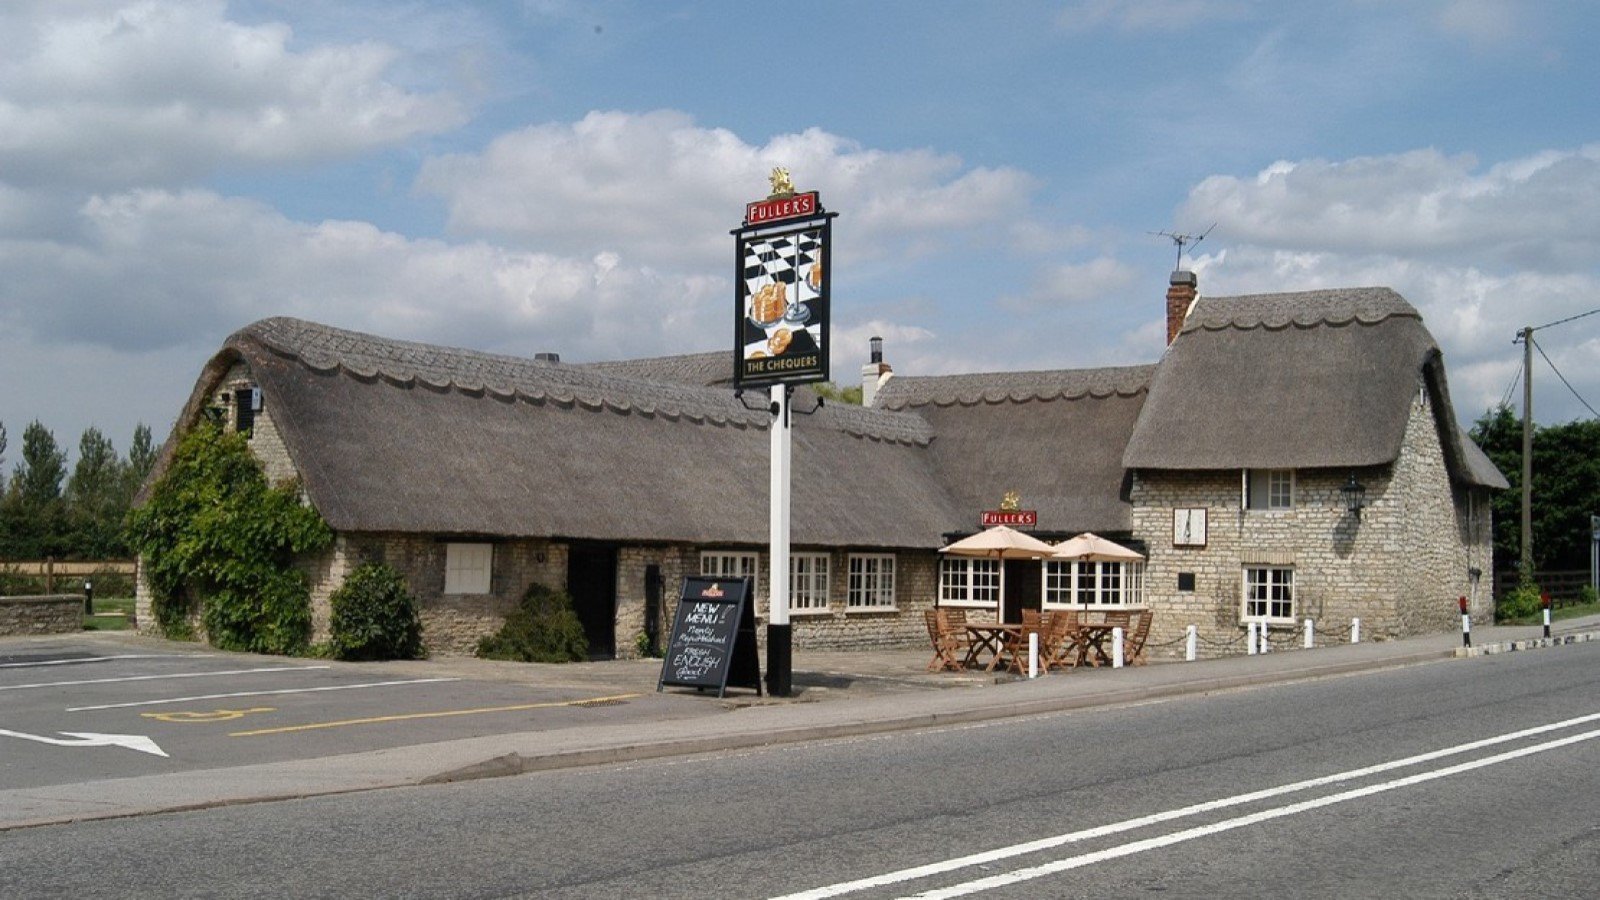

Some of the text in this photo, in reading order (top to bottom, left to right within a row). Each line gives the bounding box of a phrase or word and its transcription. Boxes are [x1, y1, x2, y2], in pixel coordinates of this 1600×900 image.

[750, 198, 810, 220] FULLER'S
[747, 356, 817, 372] THE CHEQUERS
[984, 513, 1032, 524] FULLER'S
[692, 602, 720, 613] NEW
